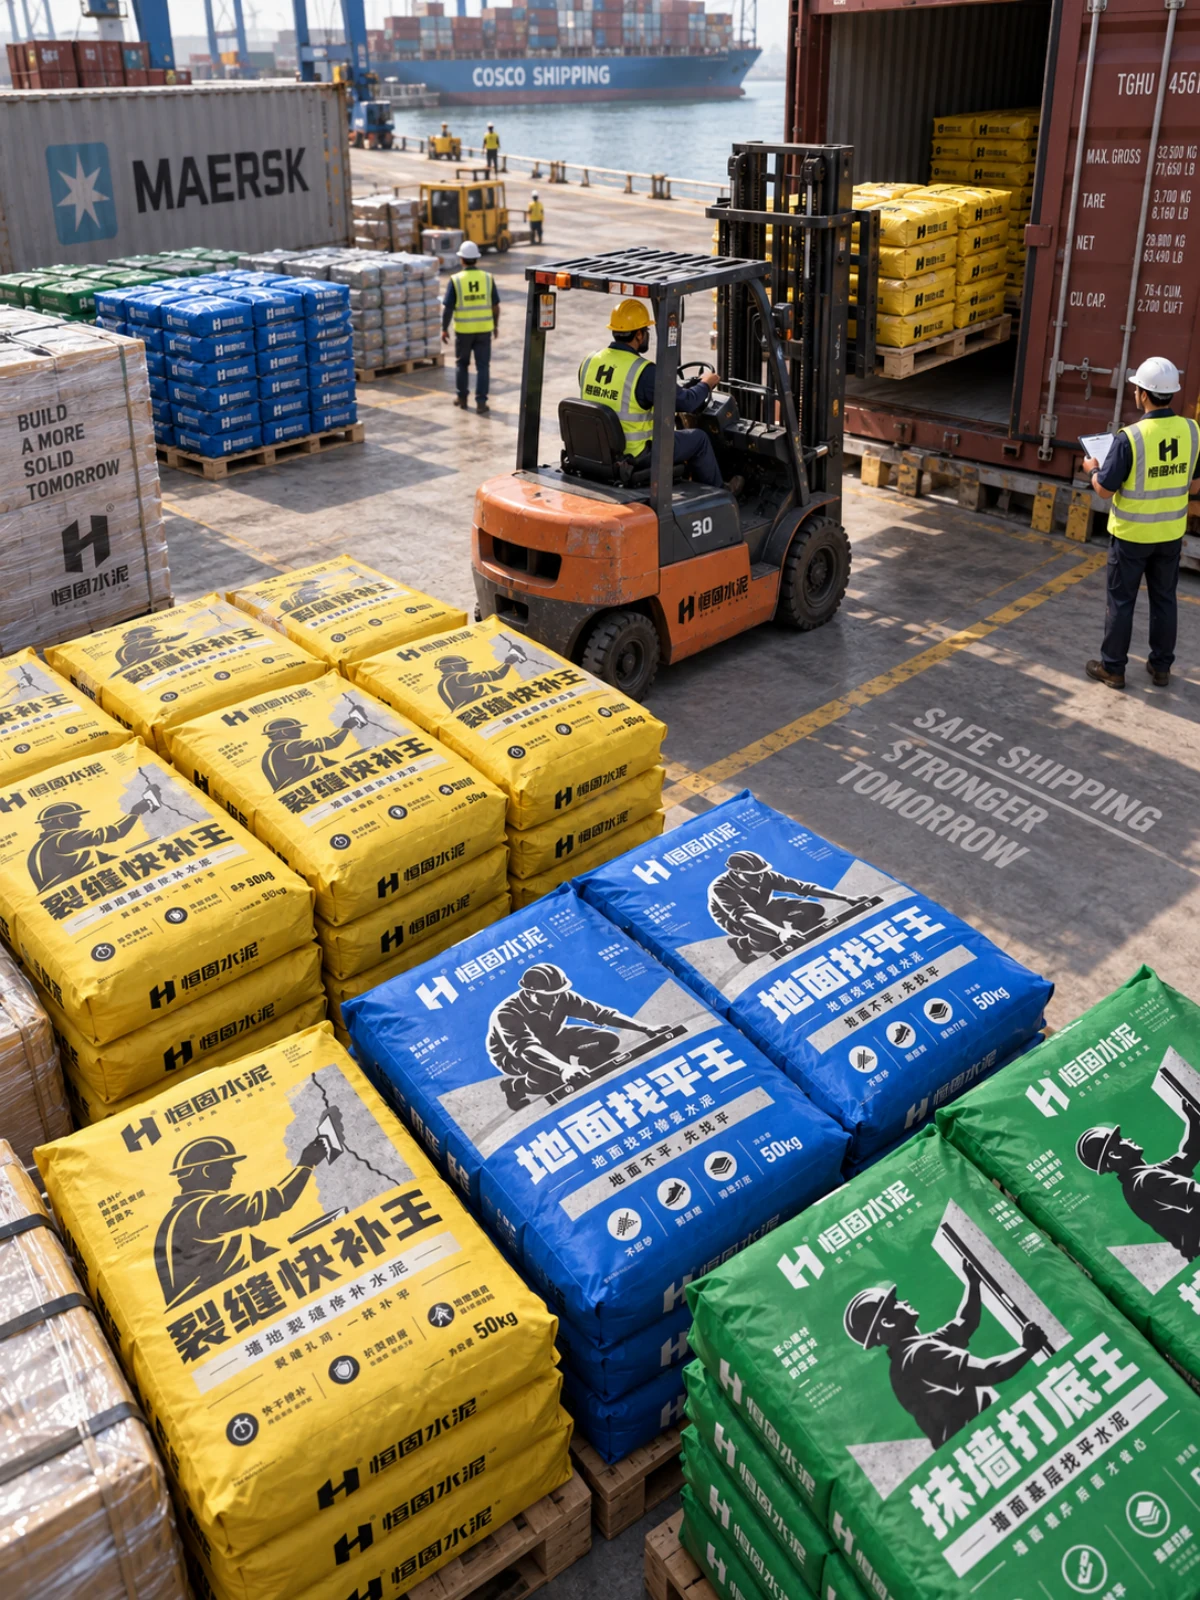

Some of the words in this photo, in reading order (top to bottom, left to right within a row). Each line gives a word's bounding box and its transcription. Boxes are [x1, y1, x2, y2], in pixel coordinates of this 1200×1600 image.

[472, 66, 526, 87] COSCO
[533, 65, 610, 86] SHIPPING
[1118, 73, 1155, 95] TGHU
[1086, 149, 1109, 164] MAX.
[1112, 149, 1141, 164] GROSS
[1187, 145, 1197, 159] KG
[1184, 162, 1195, 175] LB
[133, 147, 309, 213] MAERSK
[1083, 193, 1106, 208] TARE
[1180, 190, 1191, 204] KG
[1178, 207, 1189, 220] LB
[1076, 235, 1095, 250] NET
[1175, 234, 1186, 248] KG
[1172, 251, 1183, 264] LB
[1070, 291, 1084, 306] CU.
[1087, 292, 1106, 308] CAP.
[1163, 301, 1183, 314] CUFT
[595, 364, 614, 385] H
[17, 404, 68, 433] BUILD
[22, 439, 34, 456] A
[38, 423, 86, 451] MORE
[24, 450, 74, 478] SOLID
[1159, 437, 1178, 462] H
[26, 458, 121, 502] TOMORROW
[692, 516, 713, 538] 30
[51, 564, 129, 608] 恒固水泥
[456, 668, 587, 728] 裂缝快补王
[278, 737, 433, 814] 裂缝快补王
[881, 740, 1049, 834] STRONGER
[913, 707, 1003, 757] SAFE
[997, 746, 1163, 833] SHIPPING
[836, 761, 1031, 869] TOMORROW
[403, 842, 465, 882] 恒固水泥
[663, 822, 742, 867] 恒固水泥
[40, 822, 234, 920] 裂缝快补王
[408, 894, 470, 936] 恒固水泥
[181, 941, 259, 991] 恒固水泥
[454, 925, 548, 985] 恒固水泥
[757, 905, 946, 1025] 地面找平王
[972, 986, 1010, 1011] 50kg
[199, 1003, 275, 1050] 恒固水泥
[1058, 1022, 1142, 1088] 恒固水泥
[164, 1064, 273, 1126] 恒固水泥
[514, 1038, 747, 1186] 地面找平王
[759, 1134, 803, 1164] 50kg
[817, 1180, 915, 1254] 恒固水泥
[166, 1189, 443, 1365] 裂缝快补王
[473, 1311, 519, 1340] 50kg
[369, 1398, 477, 1475] 恒固水泥
[747, 1397, 816, 1498] 恒固水泥
[909, 1332, 1140, 1541] 抹墙打底王
[382, 1454, 487, 1531] 恒固水泥
[990, 1411, 1130, 1535] 墙面基层找平水泥
[739, 1462, 807, 1565] 恒固水泥
[391, 1506, 493, 1585] 恒固水泥
